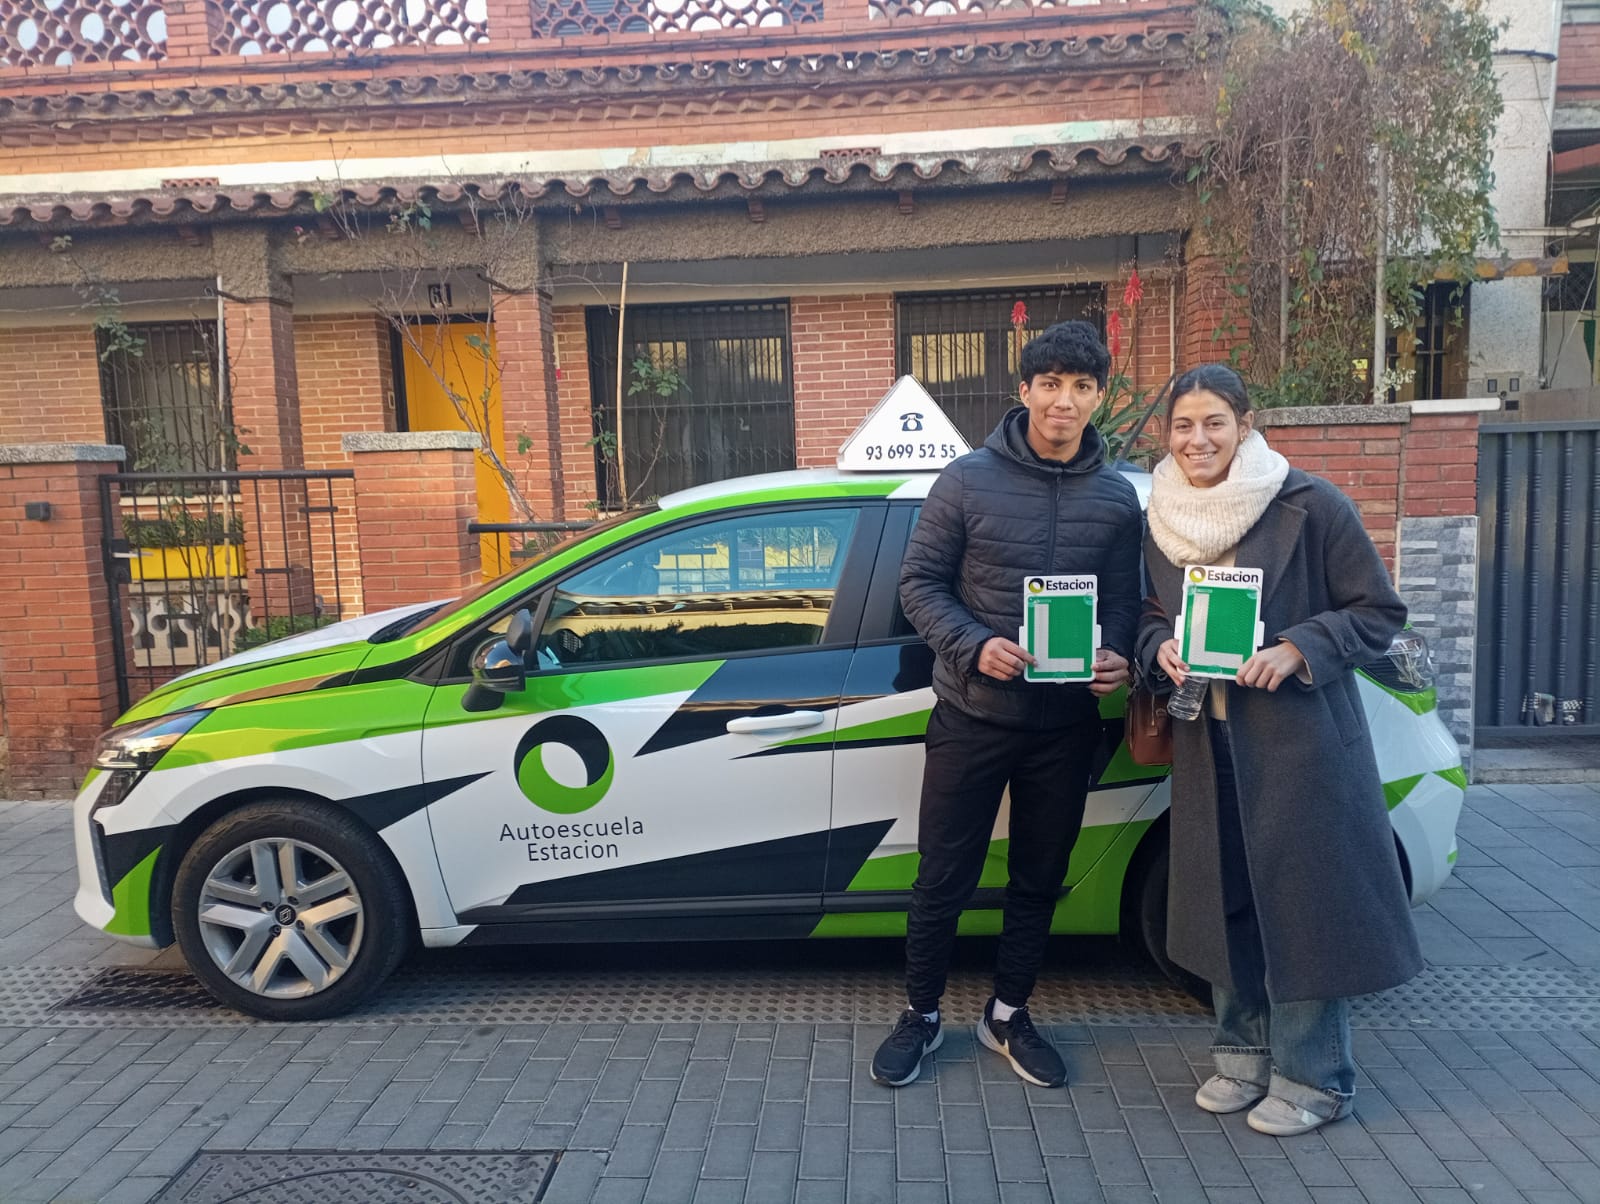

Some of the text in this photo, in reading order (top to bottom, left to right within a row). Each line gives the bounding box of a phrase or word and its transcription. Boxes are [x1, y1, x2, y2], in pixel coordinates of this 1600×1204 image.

[866, 443, 956, 460] 93 699 52 55
[1046, 579, 1094, 591] Estacion
[1207, 570, 1259, 583] Estacion
[1033, 603, 1085, 673] L
[1188, 593, 1244, 669] L
[499, 816, 643, 842] Autoescuela
[527, 839, 619, 862] Estacion
